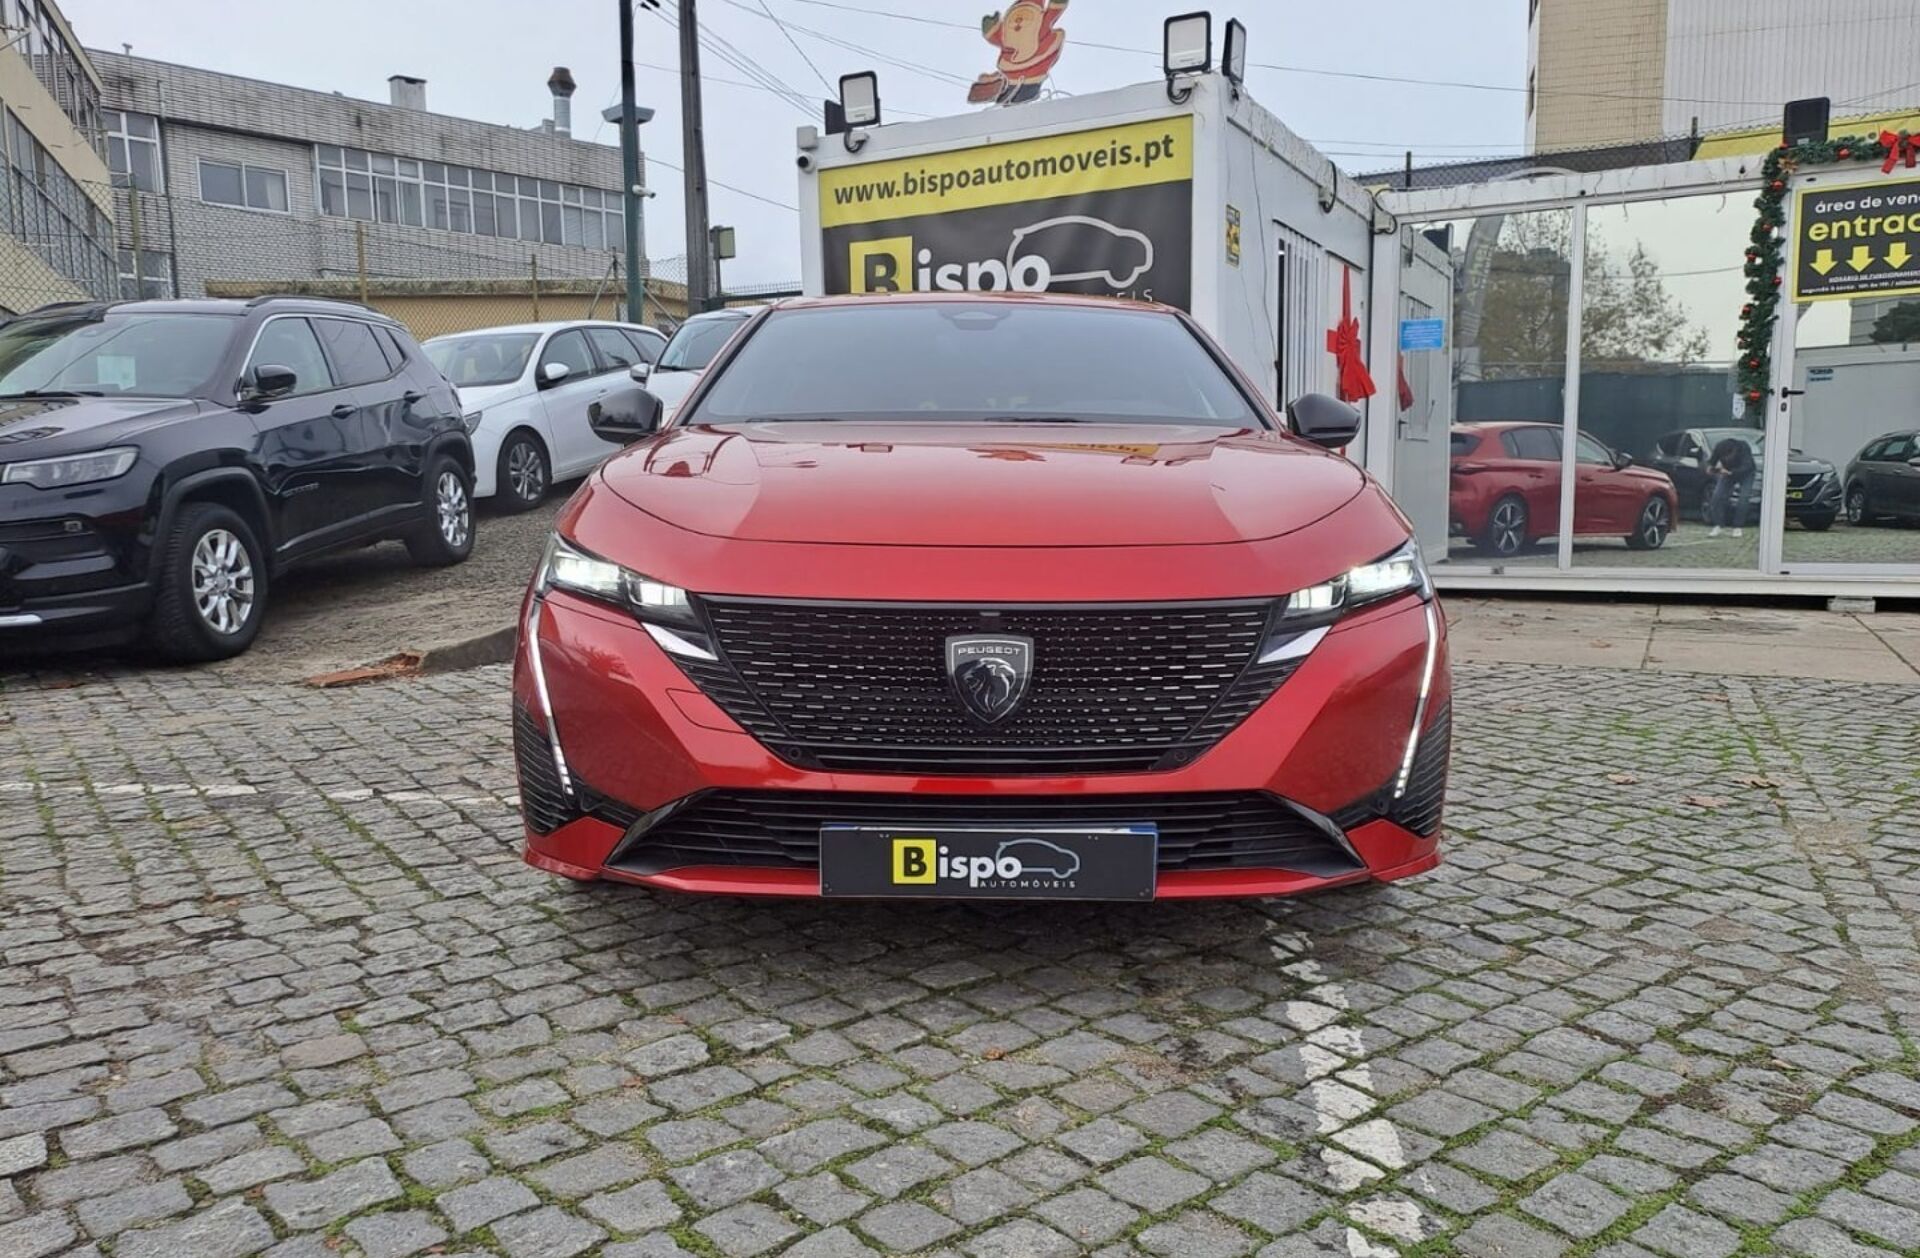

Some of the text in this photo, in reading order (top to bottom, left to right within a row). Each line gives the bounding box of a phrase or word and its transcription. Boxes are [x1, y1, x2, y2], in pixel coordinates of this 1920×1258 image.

[834, 133, 1174, 205] www.bispoautomoveis.pt
[1815, 194, 1920, 213] área de ven
[958, 646, 1021, 655] PEUGEOT
[903, 845, 1022, 888] Bispo
